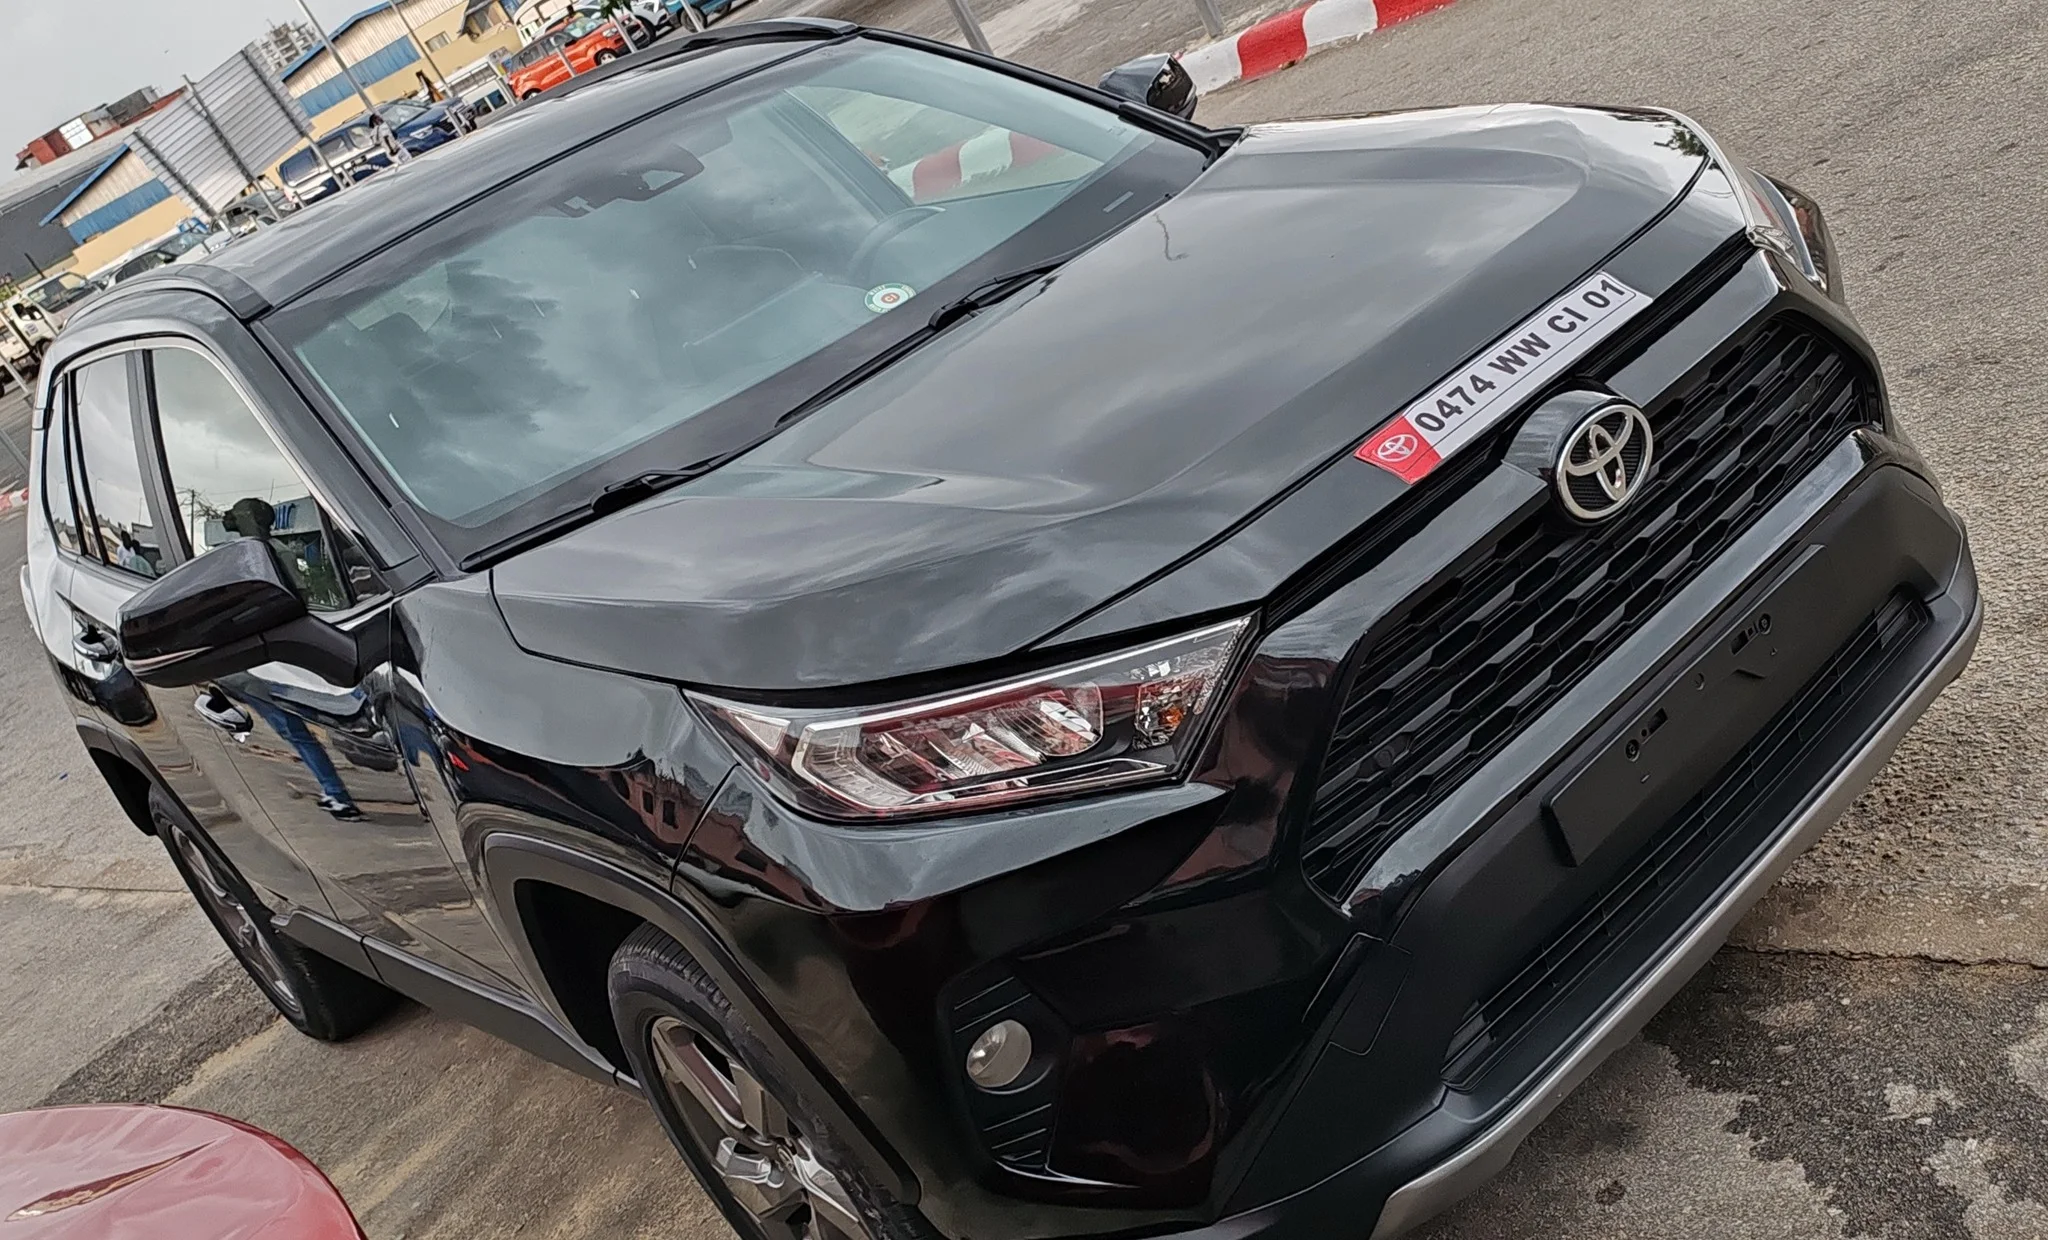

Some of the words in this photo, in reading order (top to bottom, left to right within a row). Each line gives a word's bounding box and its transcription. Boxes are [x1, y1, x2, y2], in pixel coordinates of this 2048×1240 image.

[1414, 374, 1497, 433] 0474
[1488, 332, 1552, 375] WW
[1547, 306, 1589, 334] CI
[1582, 279, 1626, 309] 01
